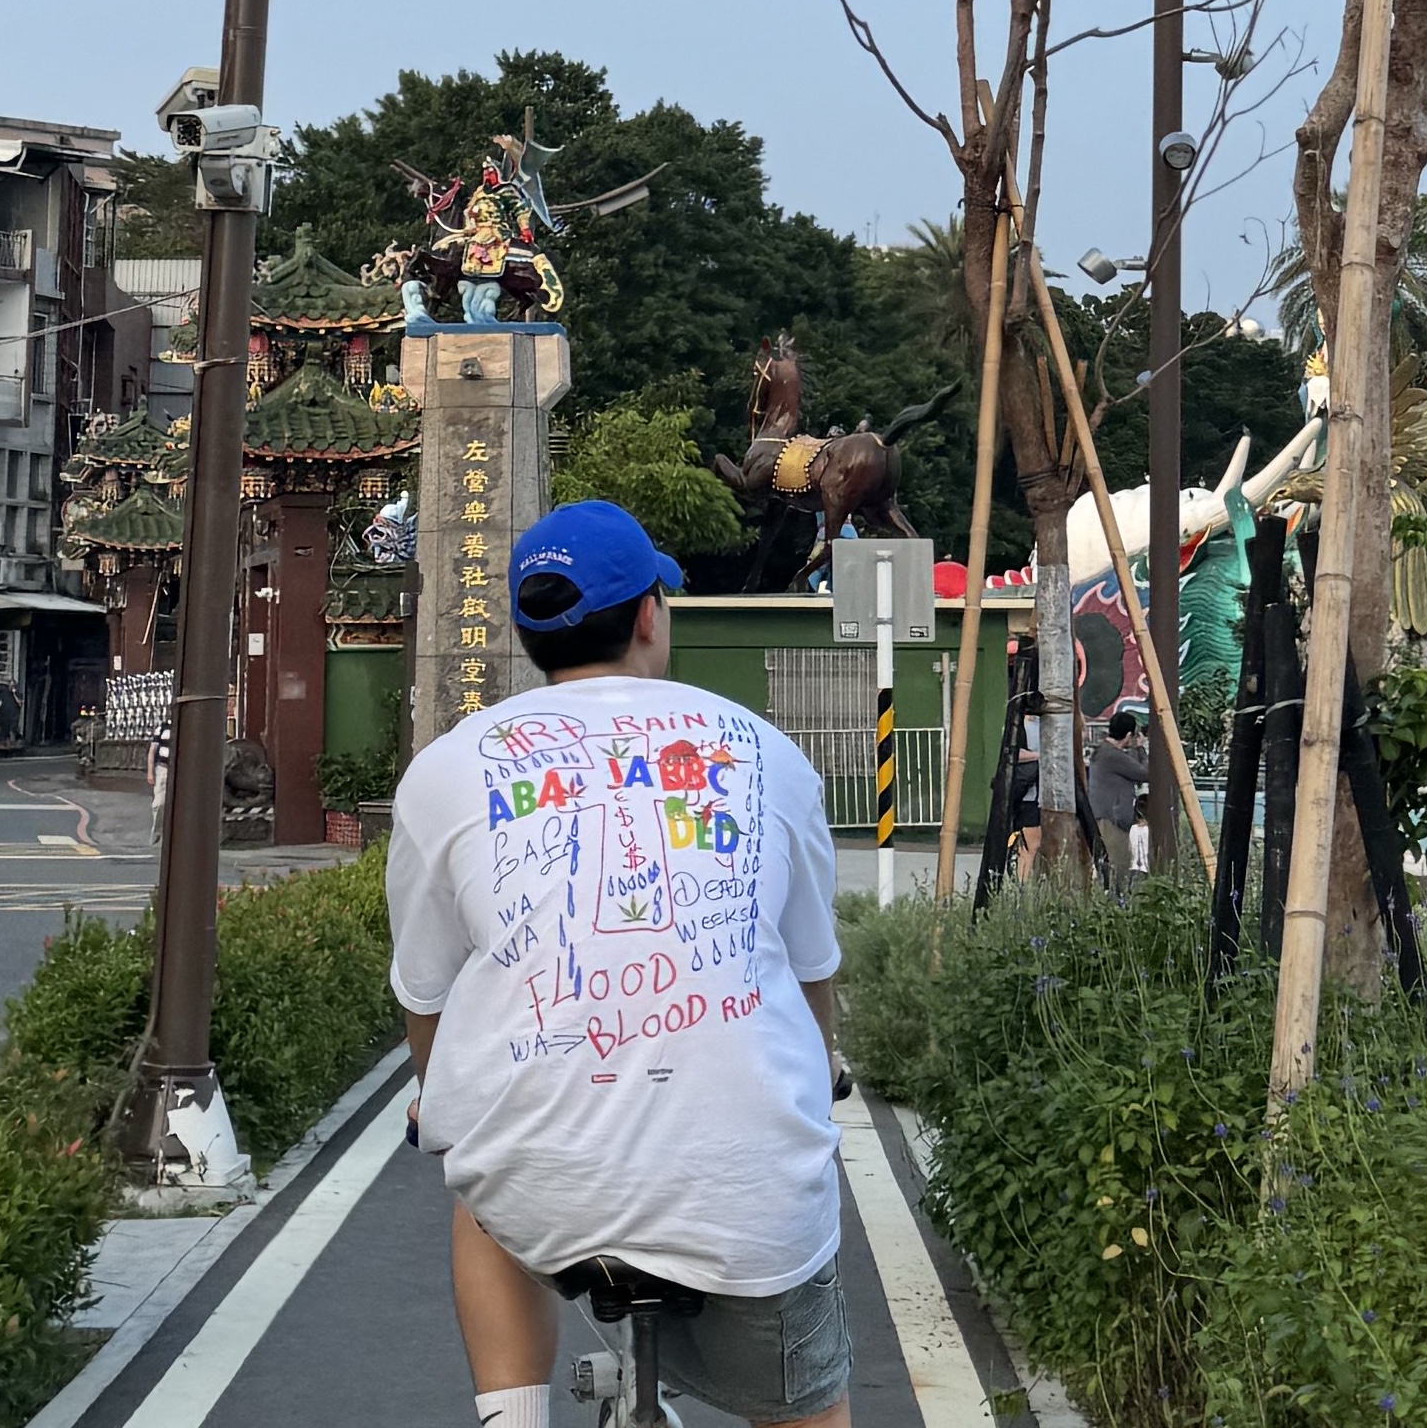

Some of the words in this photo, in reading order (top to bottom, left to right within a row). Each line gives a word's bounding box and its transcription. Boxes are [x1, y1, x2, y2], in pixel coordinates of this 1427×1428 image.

[525, 953, 677, 1032] FLOOD
[586, 994, 708, 1061] BLOOD
[722, 986, 763, 1023] RUN
